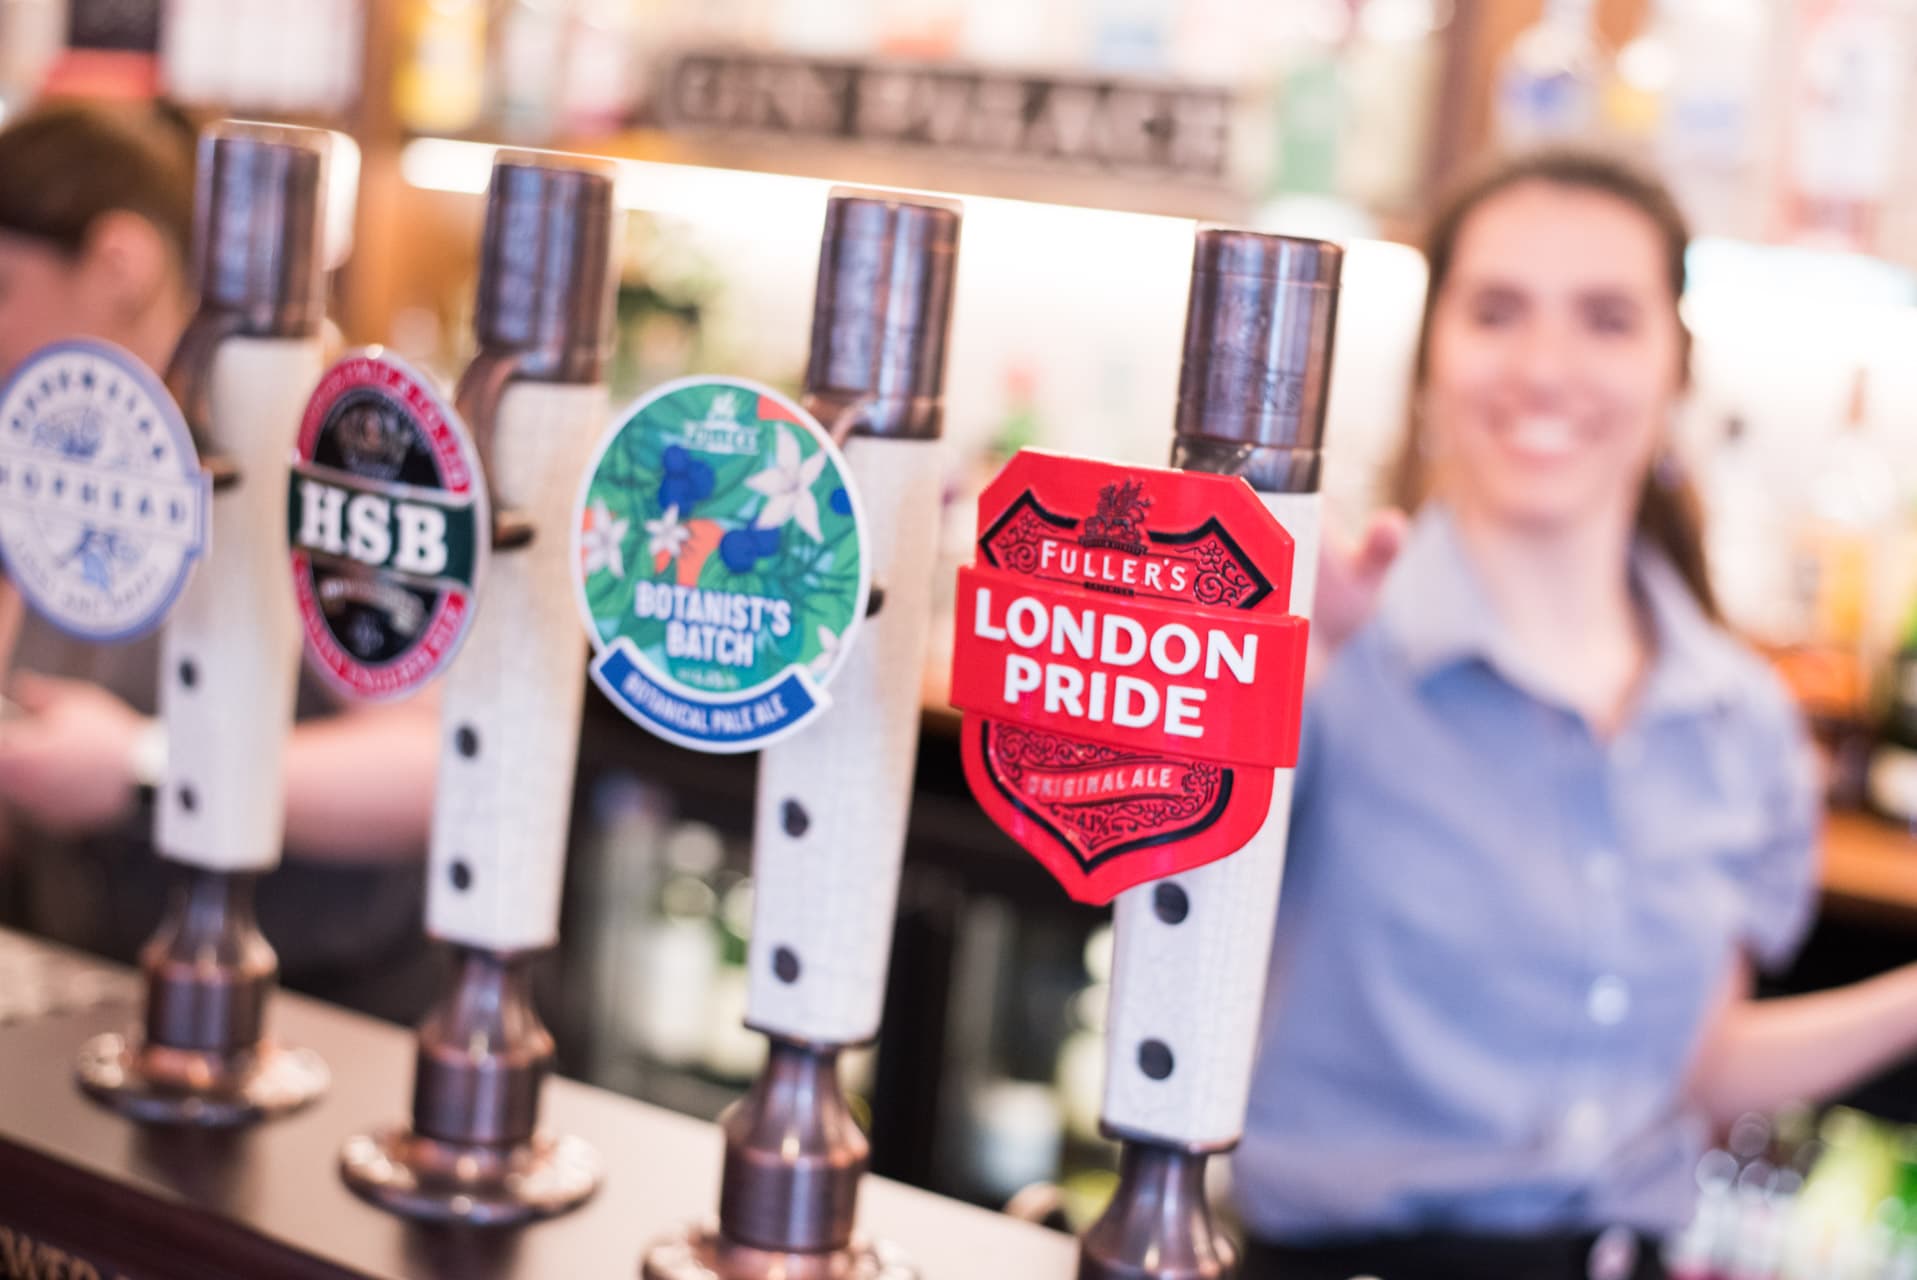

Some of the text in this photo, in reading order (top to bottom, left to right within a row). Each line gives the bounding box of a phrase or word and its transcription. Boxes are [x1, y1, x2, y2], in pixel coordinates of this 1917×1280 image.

[297, 477, 449, 577] HSB
[1040, 538, 1188, 593] FULLER'S
[634, 579, 792, 638] BOTANIST'S
[973, 587, 1259, 685] LONDON
[665, 619, 754, 668] BATCH
[621, 669, 710, 735] BOTANICAL
[709, 704, 755, 735] PALE
[753, 692, 789, 727] ALE
[1003, 653, 1208, 738] PRIDE
[1027, 766, 1173, 798] ORIGINAL ALE
